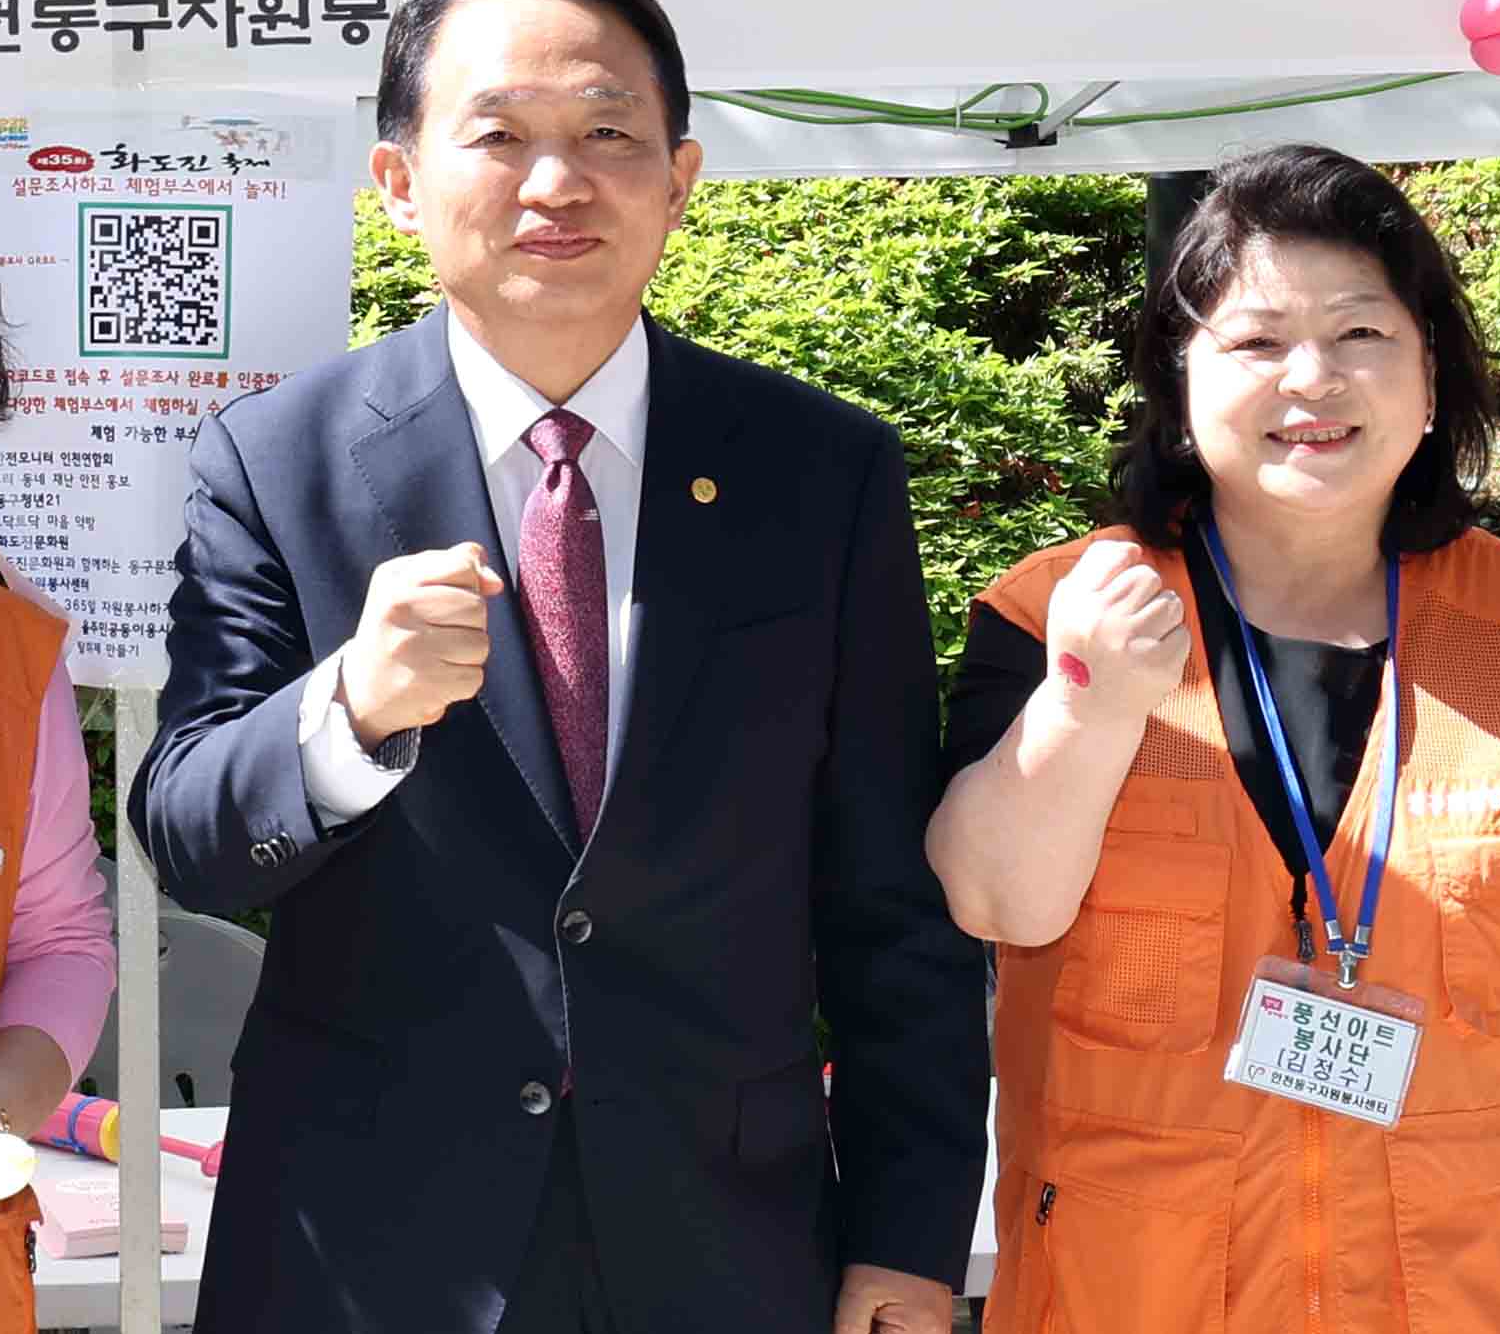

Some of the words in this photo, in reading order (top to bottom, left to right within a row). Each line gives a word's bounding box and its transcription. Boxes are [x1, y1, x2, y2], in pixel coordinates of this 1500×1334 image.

[99, 143, 212, 173] 화도진
[221, 152, 271, 175] 축제
[11, 176, 115, 198] 설문조사하고
[125, 178, 233, 197] 체험부스에서
[244, 179, 287, 200] 놀자!
[97, 370, 112, 386] 후
[119, 370, 179, 387] 설문조사
[1292, 1000, 1397, 1048] 풍선아트
[1293, 1028, 1371, 1067] 봉사단
